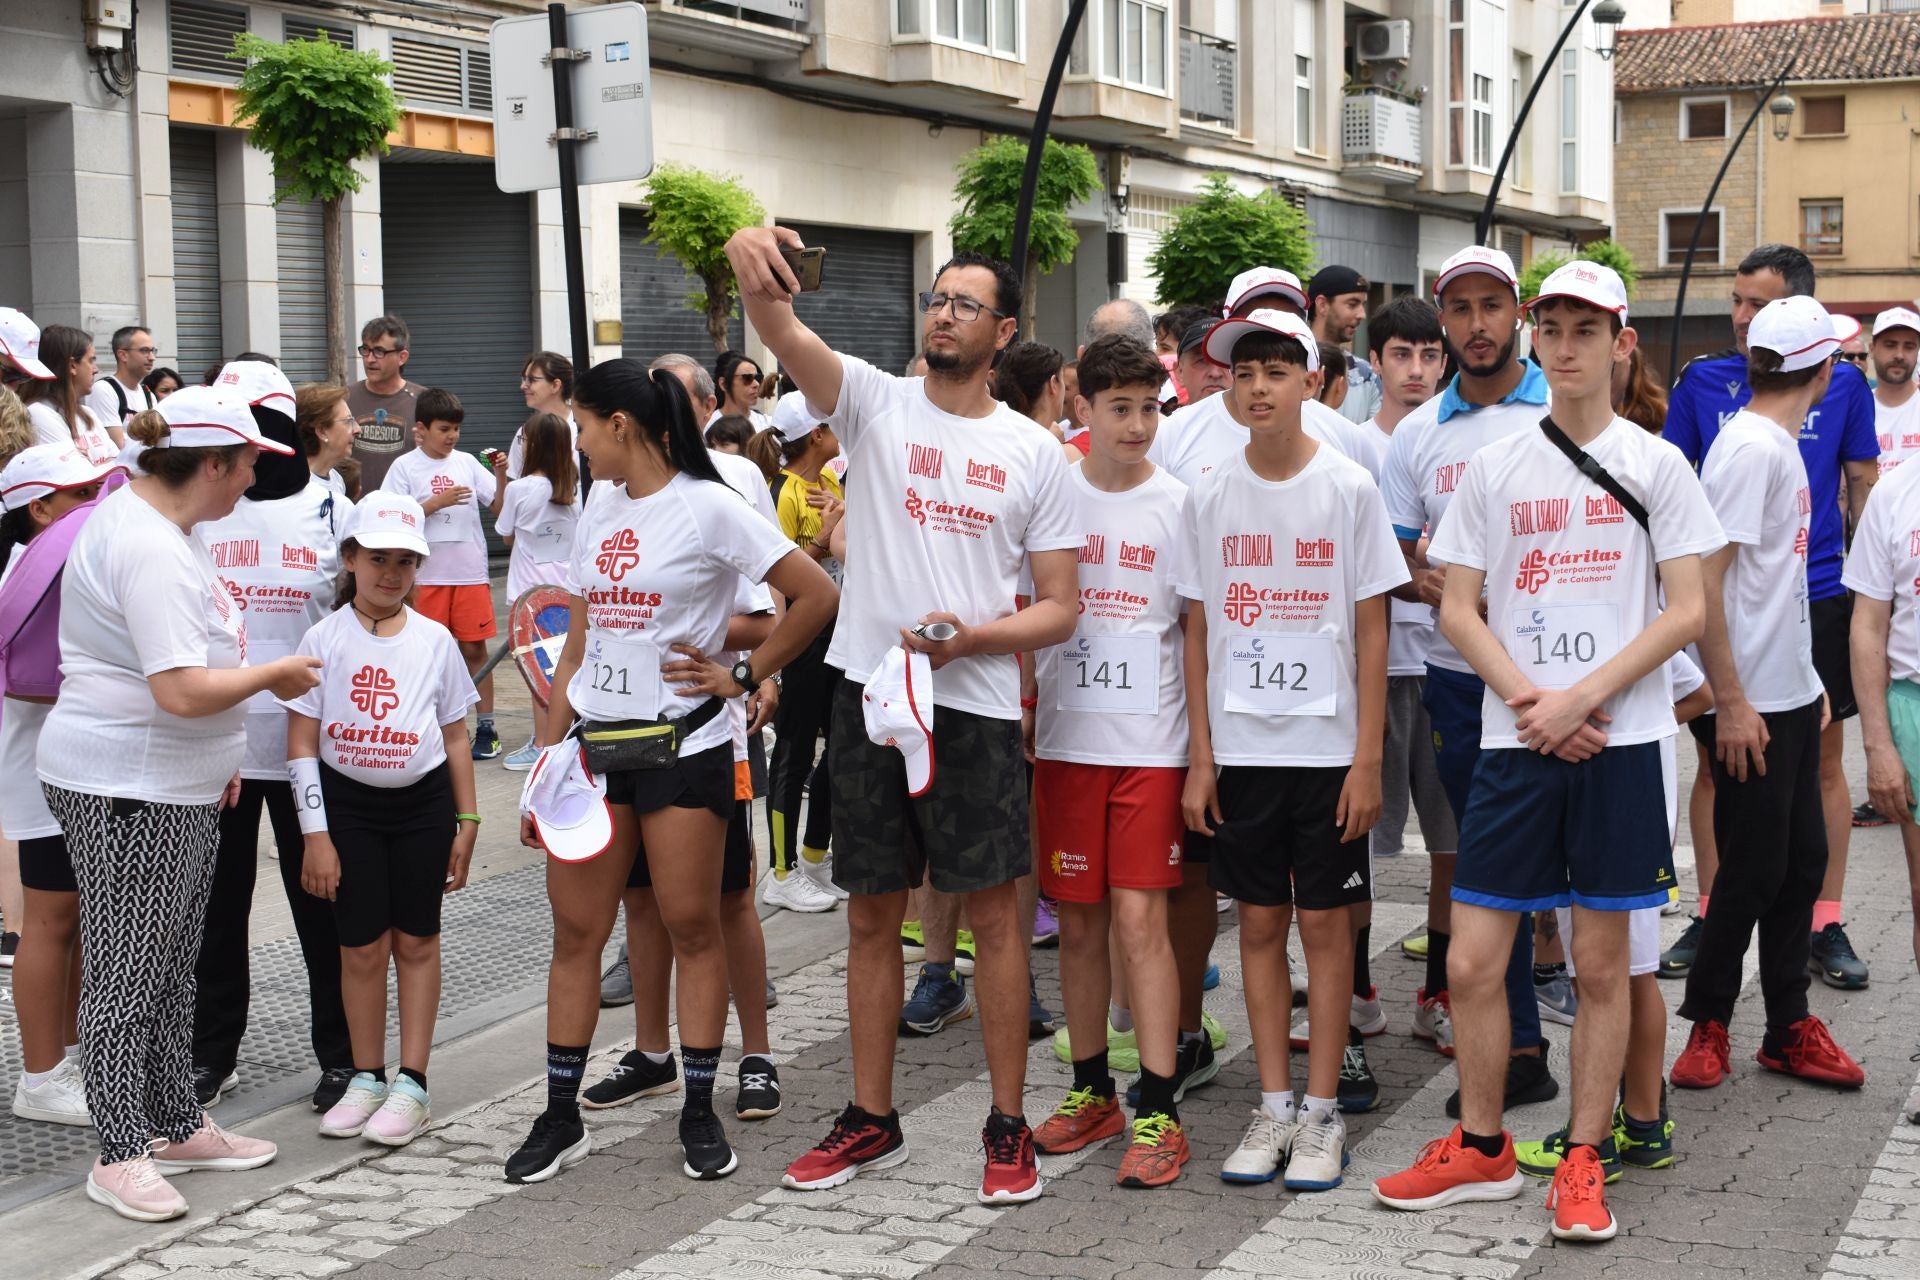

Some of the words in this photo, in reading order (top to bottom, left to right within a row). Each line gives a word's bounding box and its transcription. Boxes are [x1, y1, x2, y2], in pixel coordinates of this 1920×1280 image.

[1798, 432, 1819, 441] ciente
[905, 442, 943, 479] IDARIA
[967, 458, 1007, 486] berlin
[444, 513, 451, 524] 2
[926, 500, 995, 523] Cáritas
[929, 514, 988, 531] Interparroquial
[555, 533, 563, 544] 7
[933, 524, 942, 532] de
[945, 525, 981, 539] Calahorra
[214, 539, 260, 568] SOLIDARIA
[282, 543, 318, 565] berlin
[1120, 540, 1156, 566] berlin
[1226, 535, 1273, 567] SOLIDARIA
[1296, 538, 1334, 559] berlin
[1548, 550, 1622, 566] Cáritas
[1554, 564, 1616, 576] Interparroquial
[1570, 575, 1612, 583] Calahorra
[245, 585, 311, 599] Cáritas
[1084, 588, 1149, 605] Cáritas
[1260, 588, 1329, 601] Cáritas
[251, 598, 304, 607] Interparroquia
[1089, 602, 1142, 613] Interparroquial
[1266, 603, 1323, 612] Interparroquial
[1101, 610, 1136, 619] Calahorra
[597, 618, 646, 630] Calahorra
[1516, 625, 1546, 634] Calahorra
[1063, 650, 1091, 659] Calahorra
[1233, 651, 1265, 659] Calahorra
[1531, 632, 1596, 665] 140
[592, 662, 632, 695] 121
[1076, 660, 1132, 689] 141
[1249, 661, 1308, 691] 142
[327, 722, 419, 746] Cáritas
[334, 741, 412, 758] Interparroquial
[338, 754, 348, 765] de
[351, 756, 405, 769] Calahorra
[1061, 852, 1087, 862] Ramiro
[548, 1065, 572, 1077] TMB
